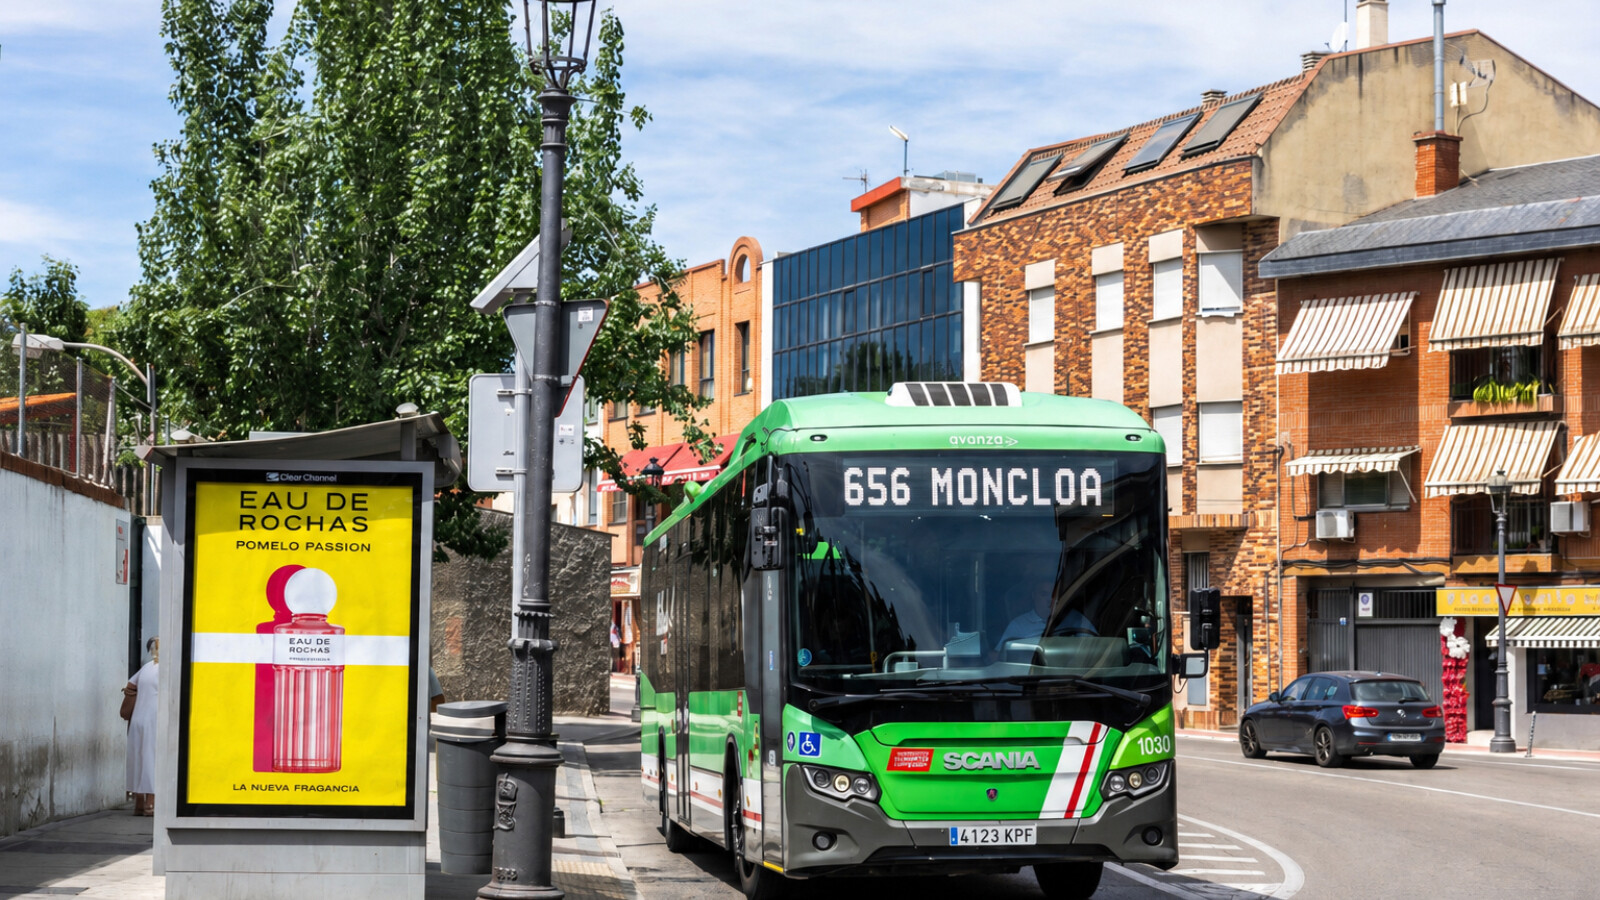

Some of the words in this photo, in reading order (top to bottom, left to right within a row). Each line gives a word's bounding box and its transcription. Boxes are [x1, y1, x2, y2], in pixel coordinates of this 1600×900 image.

[949, 434, 1003, 446] avanza
[280, 473, 301, 481] Clear
[303, 474, 337, 482] Channel
[844, 467, 911, 506] 656
[931, 467, 1102, 506] MONCLOA
[240, 490, 308, 510] EAU
[327, 493, 369, 511] DE
[239, 514, 369, 532] ROCHAS
[236, 540, 299, 551] POMELO
[305, 542, 371, 552] PASSION
[1137, 735, 1171, 756] 1030
[943, 751, 1041, 771] SCANIA
[251, 784, 290, 792] NUEVA
[294, 784, 360, 793] FRAGANCIA
[959, 826, 999, 844] 4123
[1004, 825, 1034, 843] KPF
